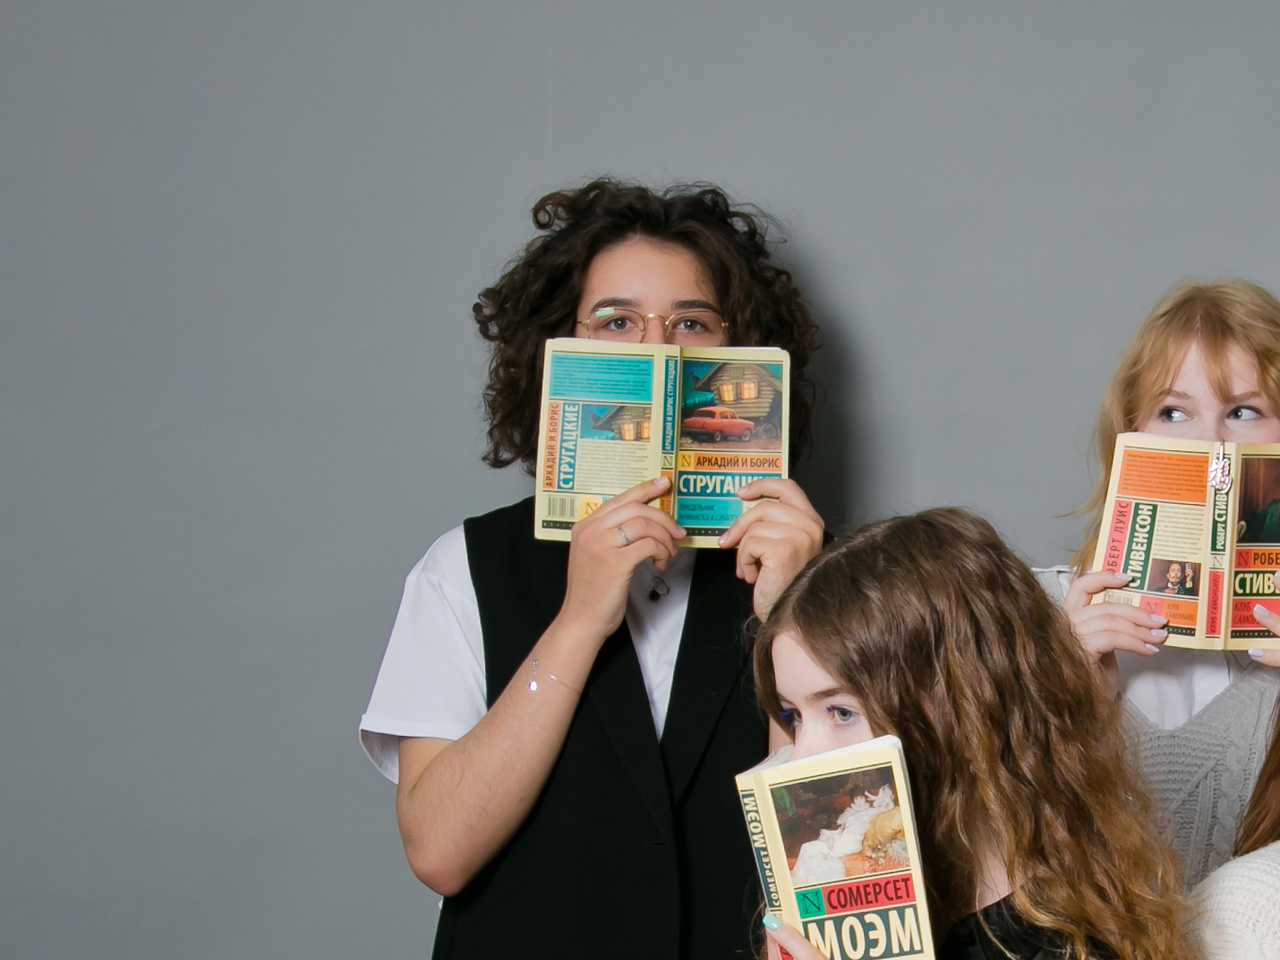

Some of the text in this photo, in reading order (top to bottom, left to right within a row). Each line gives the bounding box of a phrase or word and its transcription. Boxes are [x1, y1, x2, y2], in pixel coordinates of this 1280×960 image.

[548, 403, 560, 433] БОРИС
[559, 404, 579, 489] СТРУГАЦКИЕ
[696, 456, 780, 468] АРКАДИЙ И БОРИС
[545, 444, 557, 488] АРКАДИЙ
[1115, 502, 1130, 534] ЛУИС
[1127, 503, 1153, 588] СТИВЕНСОН
[743, 795, 781, 907] СОМЕРСЕТ МОЭМ
[827, 877, 912, 910] СОМЕРСЕТ
